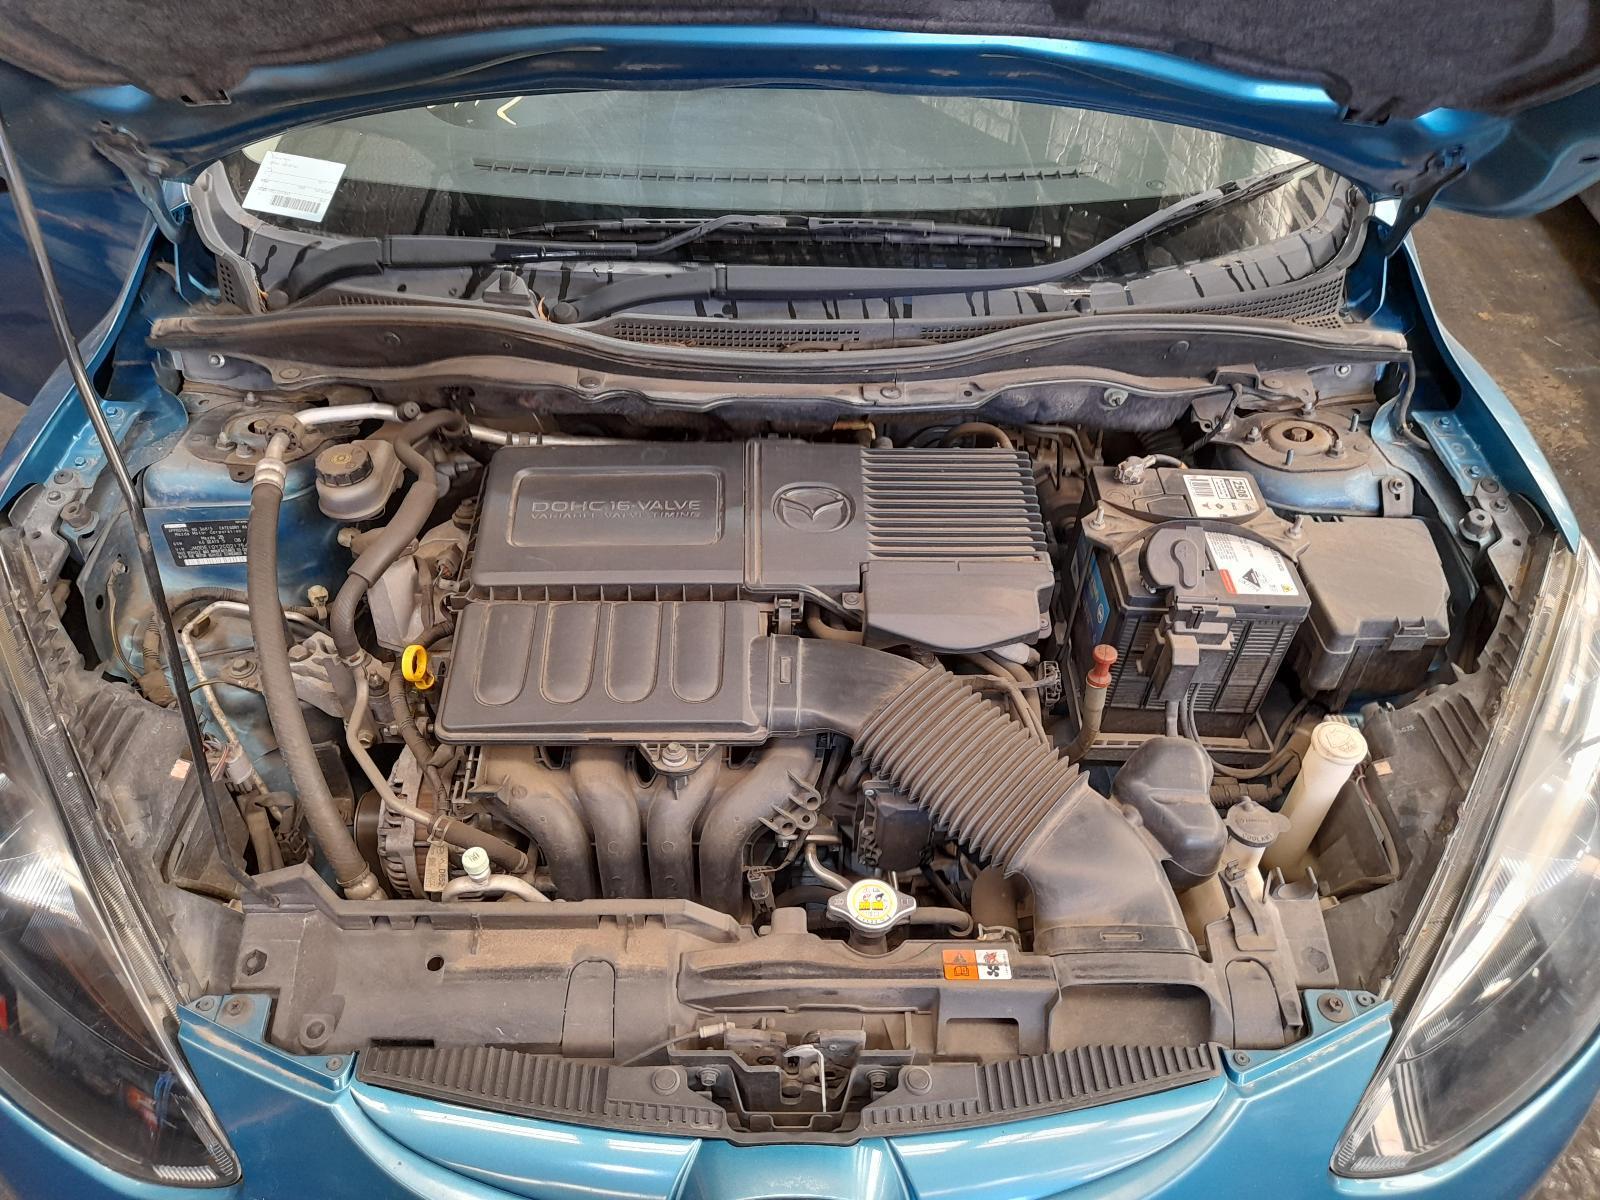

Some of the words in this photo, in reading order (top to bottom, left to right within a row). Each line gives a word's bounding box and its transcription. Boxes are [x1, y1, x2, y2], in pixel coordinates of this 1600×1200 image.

[1232, 480, 1249, 498] 2508
[532, 501, 606, 512] DOHC
[610, 500, 701, 511] 16-VALVE
